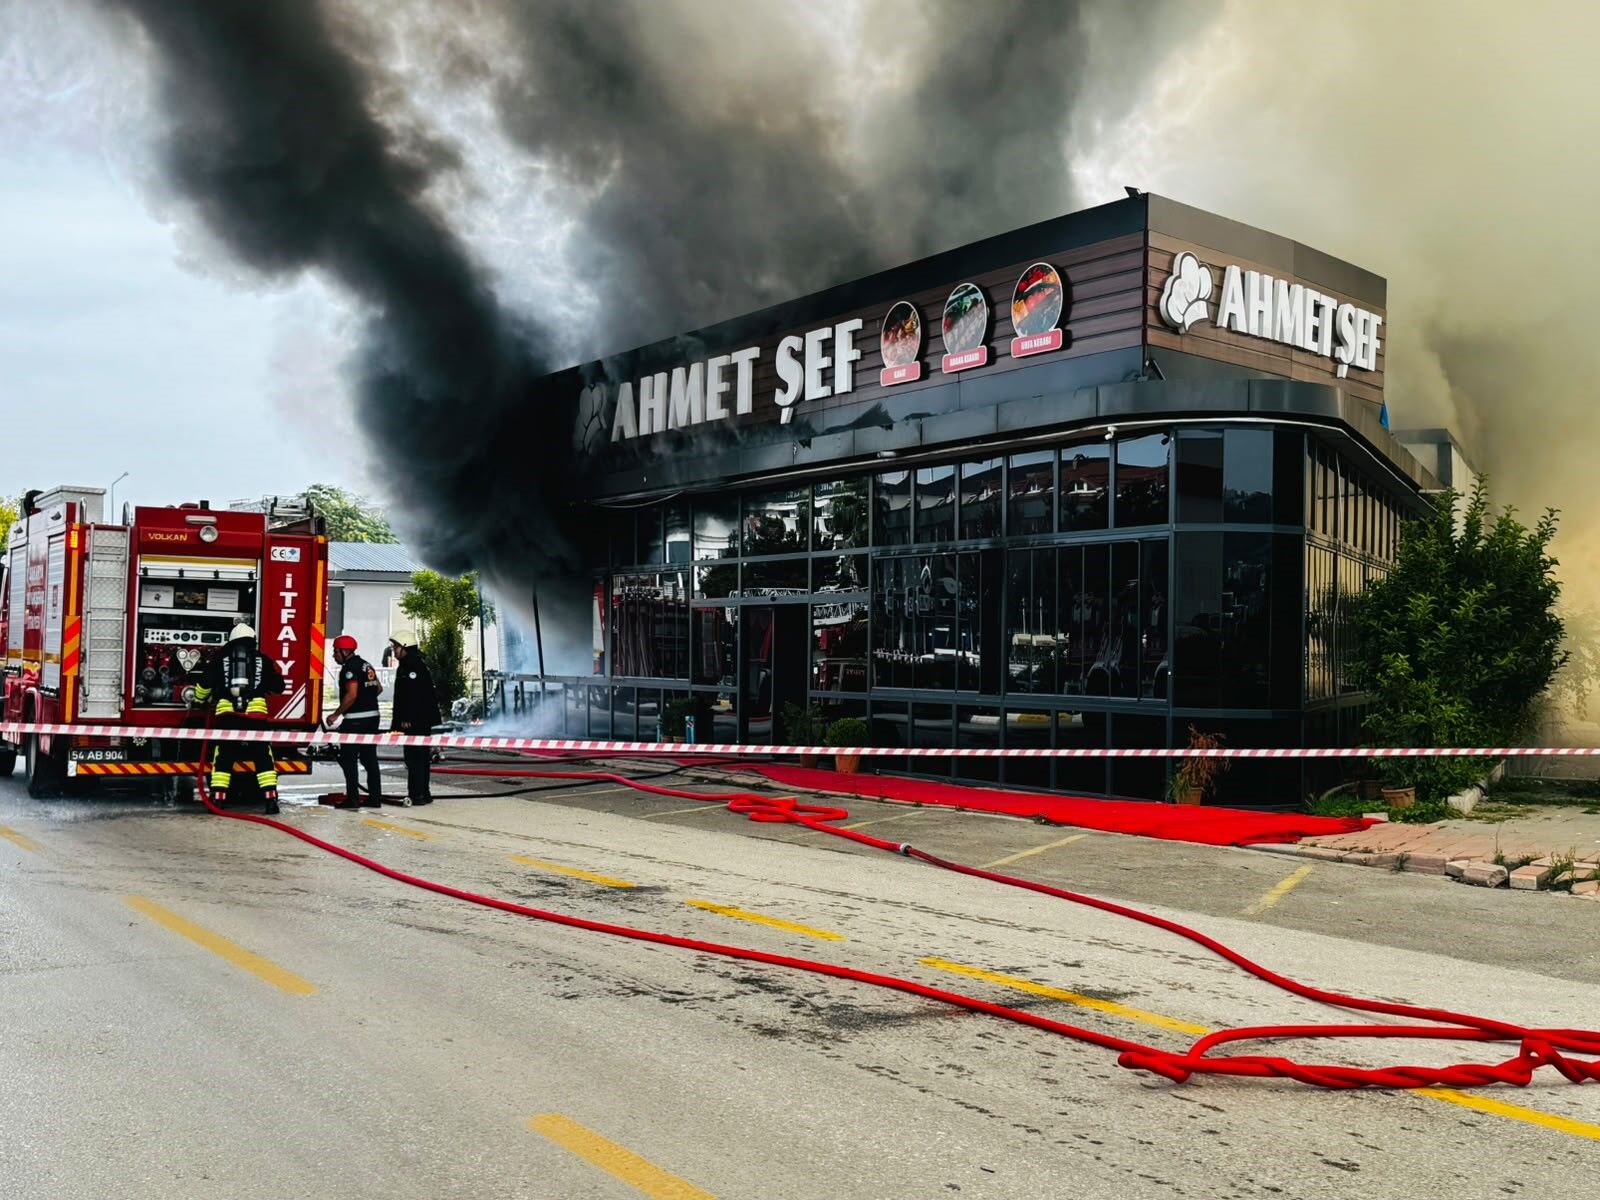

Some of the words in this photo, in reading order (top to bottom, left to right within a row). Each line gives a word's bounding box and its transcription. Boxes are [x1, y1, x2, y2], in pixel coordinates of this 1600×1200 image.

[1216, 265, 1337, 357] AHMET
[1335, 303, 1382, 379] ŞEF
[611, 346, 760, 442] AHMET
[774, 318, 863, 424] ŞEF
[148, 532, 188, 541] VOLKAN
[72, 750, 84, 760] 54
[87, 750, 103, 760] AB
[105, 750, 123, 760] 904
